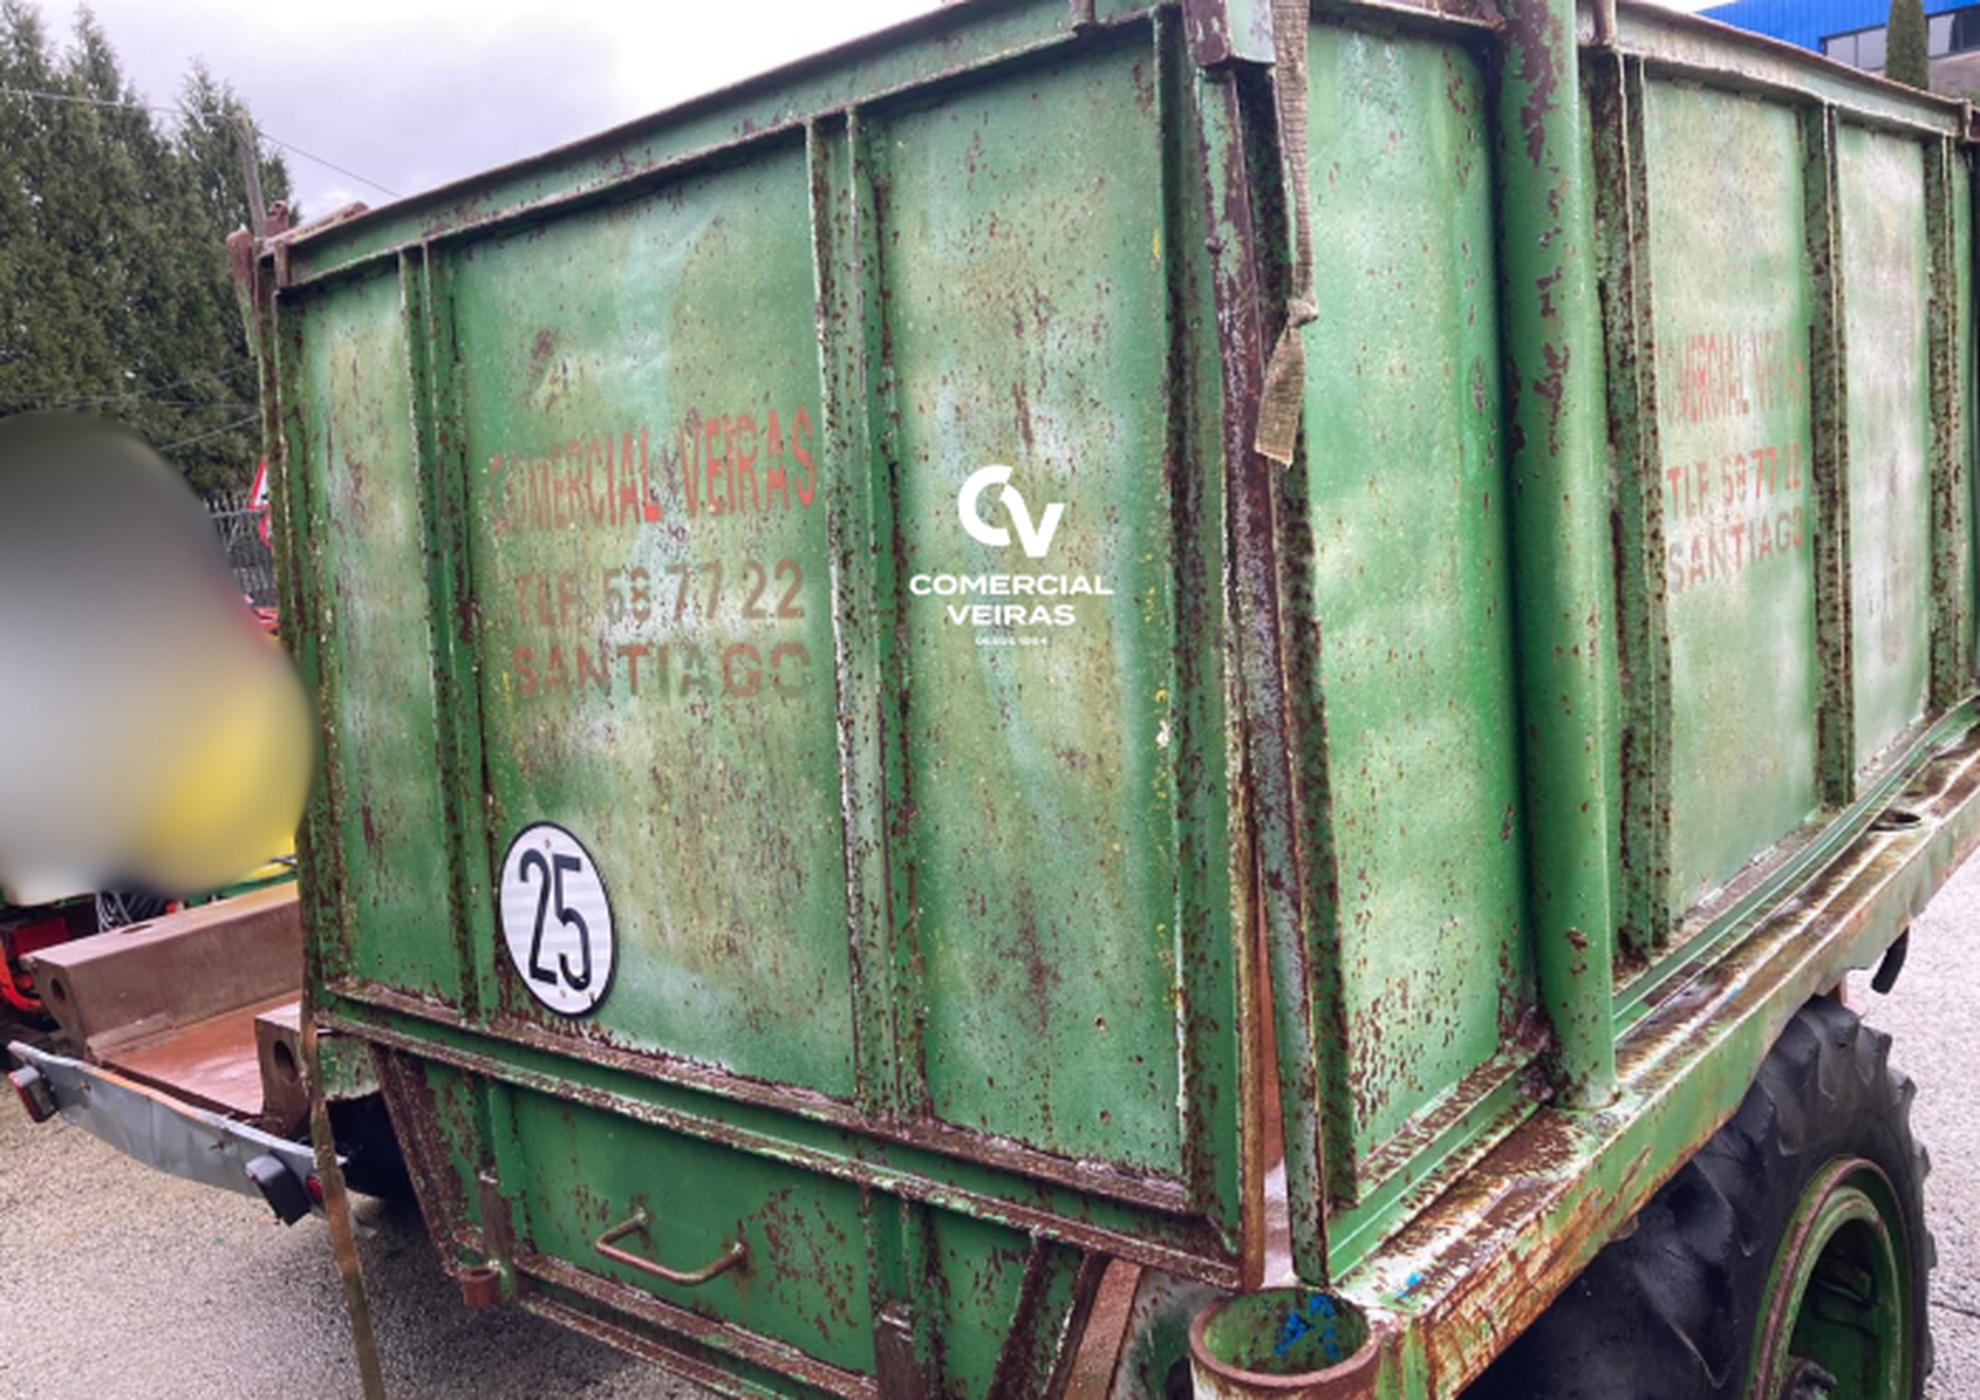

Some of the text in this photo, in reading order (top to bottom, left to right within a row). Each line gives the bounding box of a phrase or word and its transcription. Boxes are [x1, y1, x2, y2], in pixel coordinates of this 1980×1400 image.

[678, 406, 816, 519] VEIRAS
[1669, 507, 1804, 593] SANTIAGO
[512, 641, 809, 697] SANTIAGO
[519, 849, 591, 990] 25
